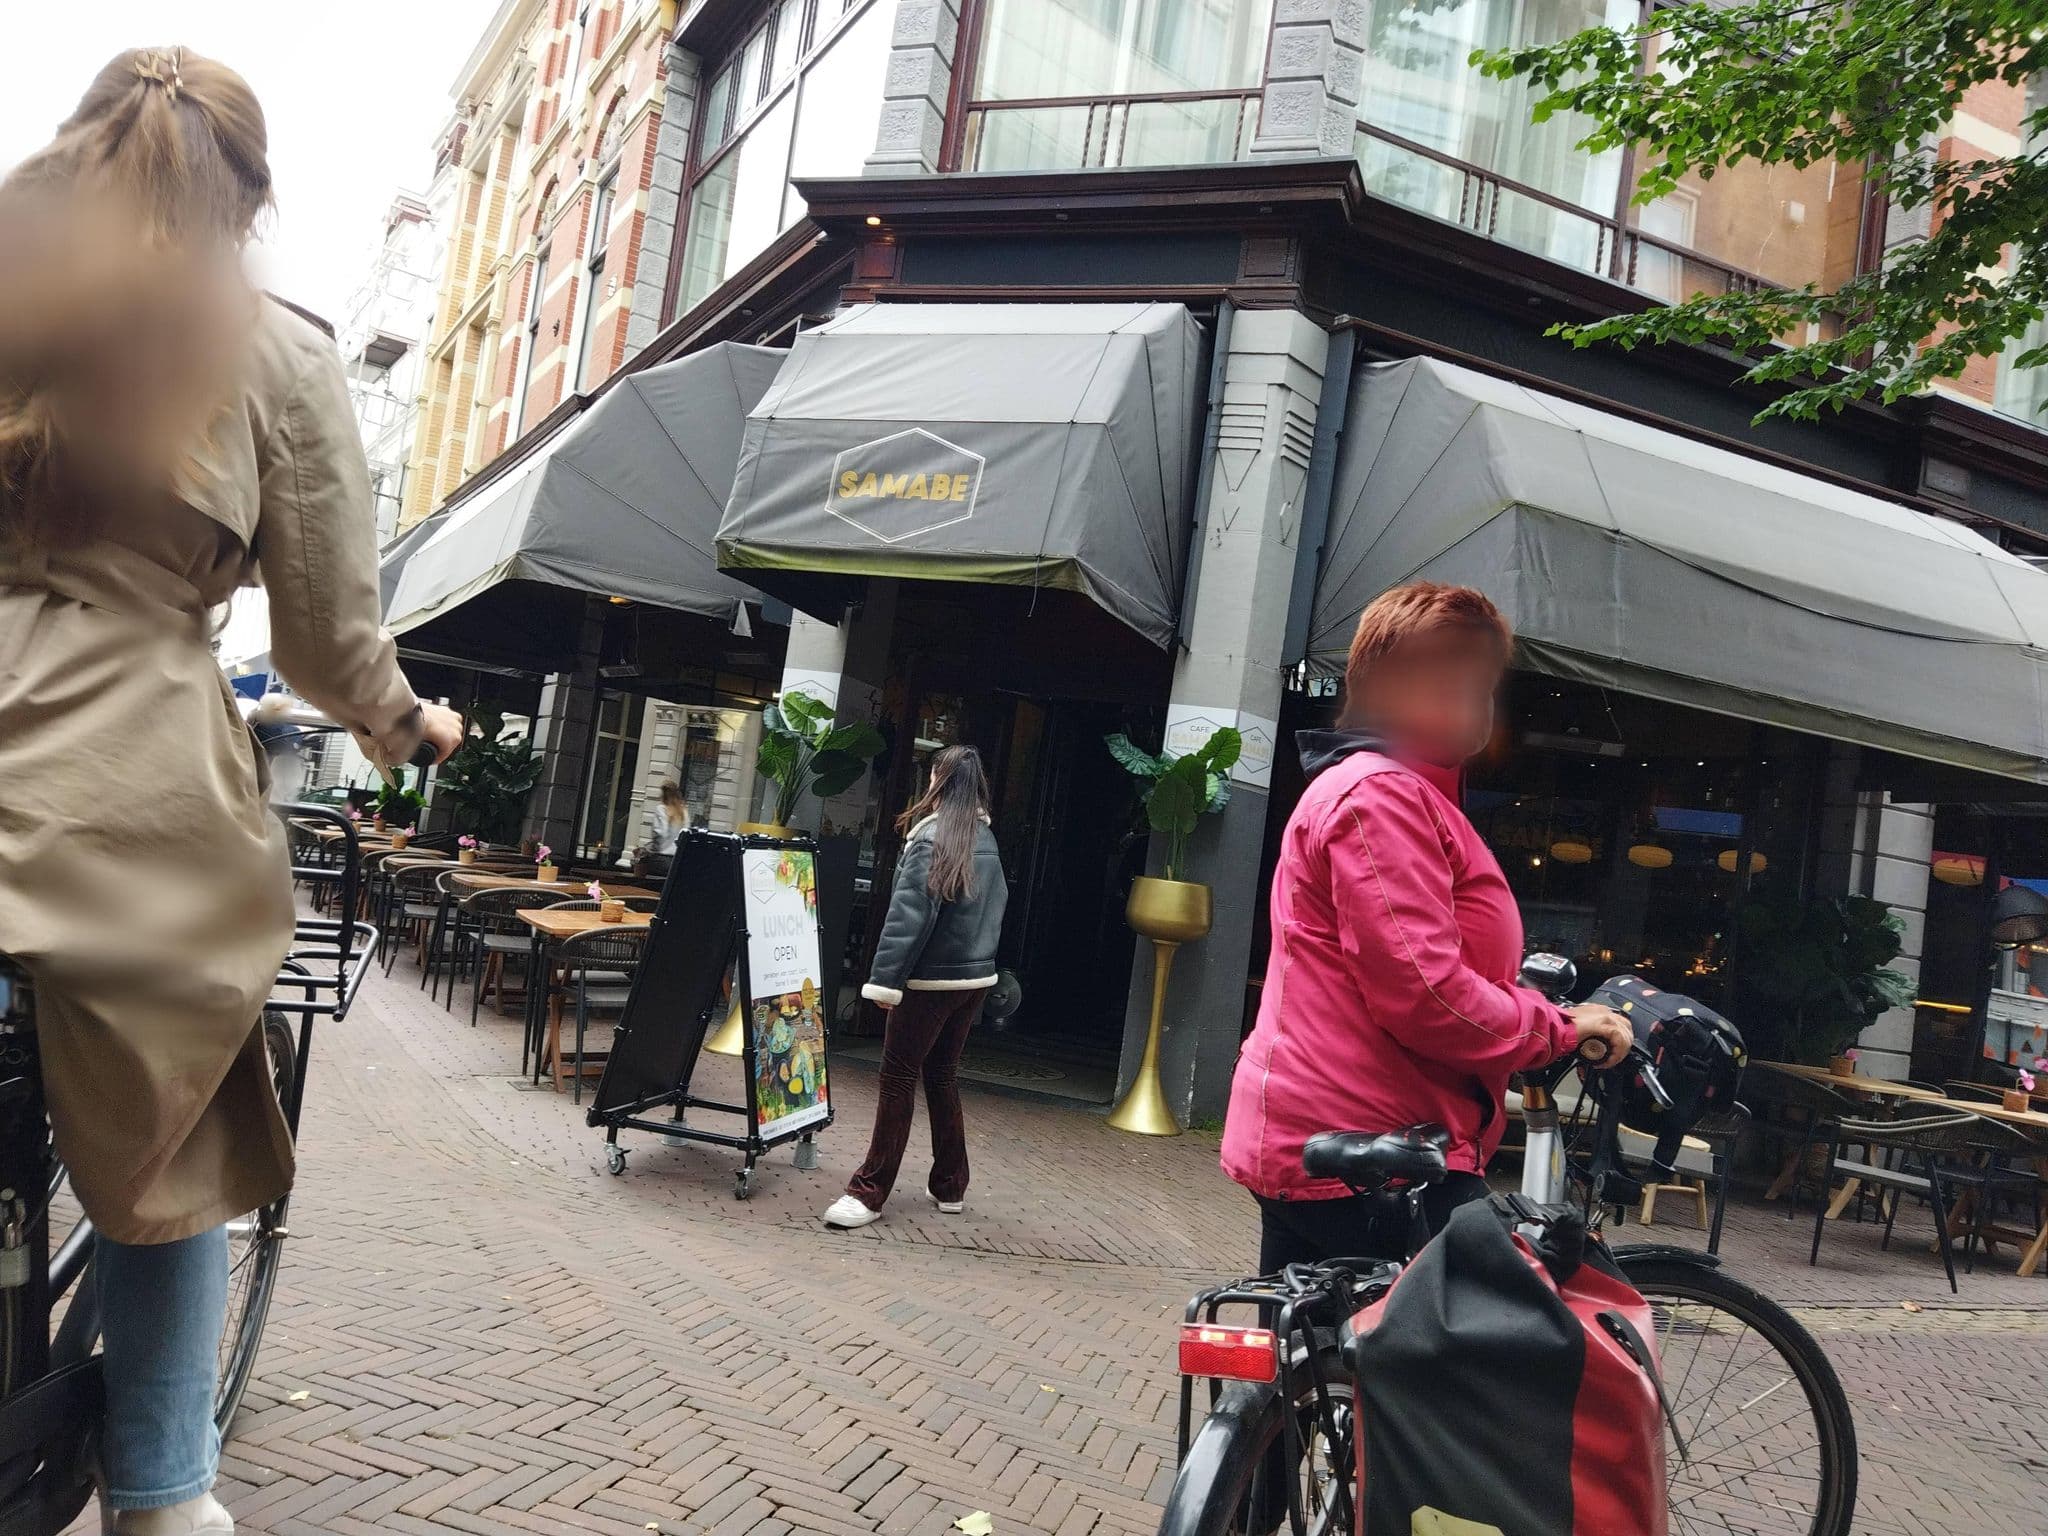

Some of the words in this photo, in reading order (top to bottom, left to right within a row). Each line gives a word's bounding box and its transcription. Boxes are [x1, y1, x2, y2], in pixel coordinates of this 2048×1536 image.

[839, 470, 969, 501] SAMABE
[763, 914, 804, 938] LUNCH
[773, 945, 797, 961] OPEN
